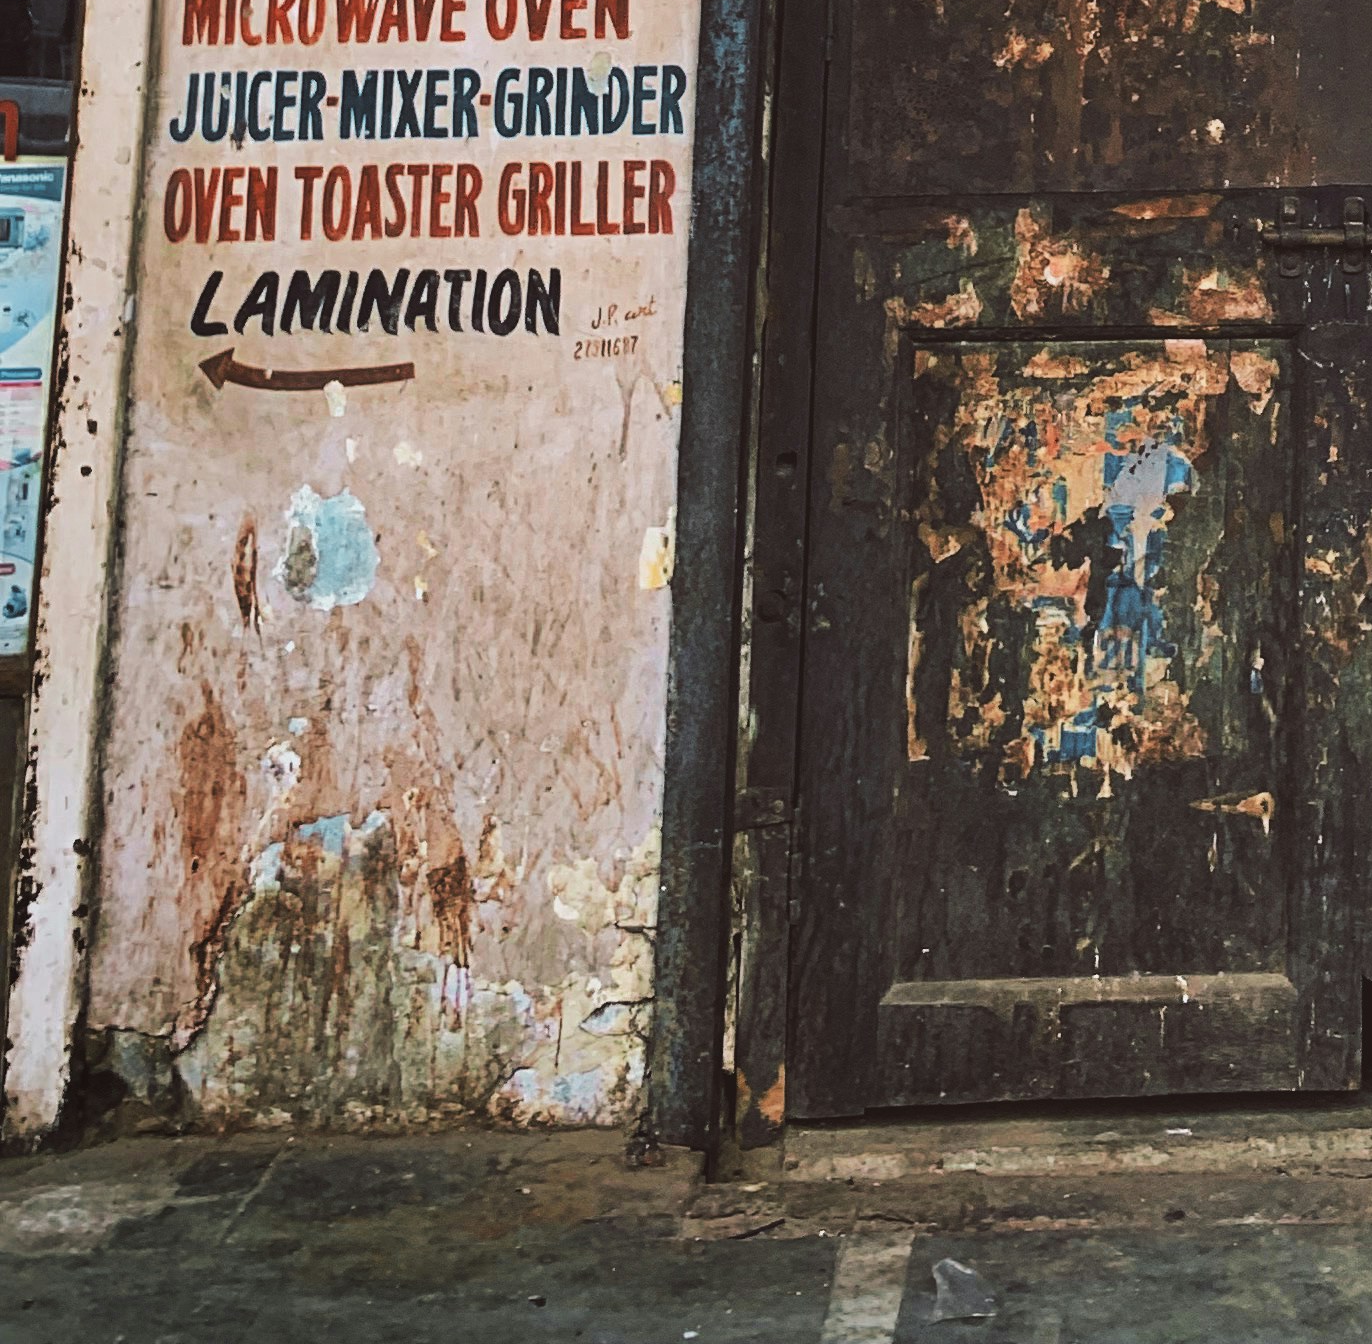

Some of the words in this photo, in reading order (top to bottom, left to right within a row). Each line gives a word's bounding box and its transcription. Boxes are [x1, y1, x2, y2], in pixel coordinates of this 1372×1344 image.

[162, 166, 278, 245] OVEN
[294, 163, 483, 242] TOASTER
[498, 159, 676, 237] GRILLER
[189, 268, 562, 337] LAMINATION
